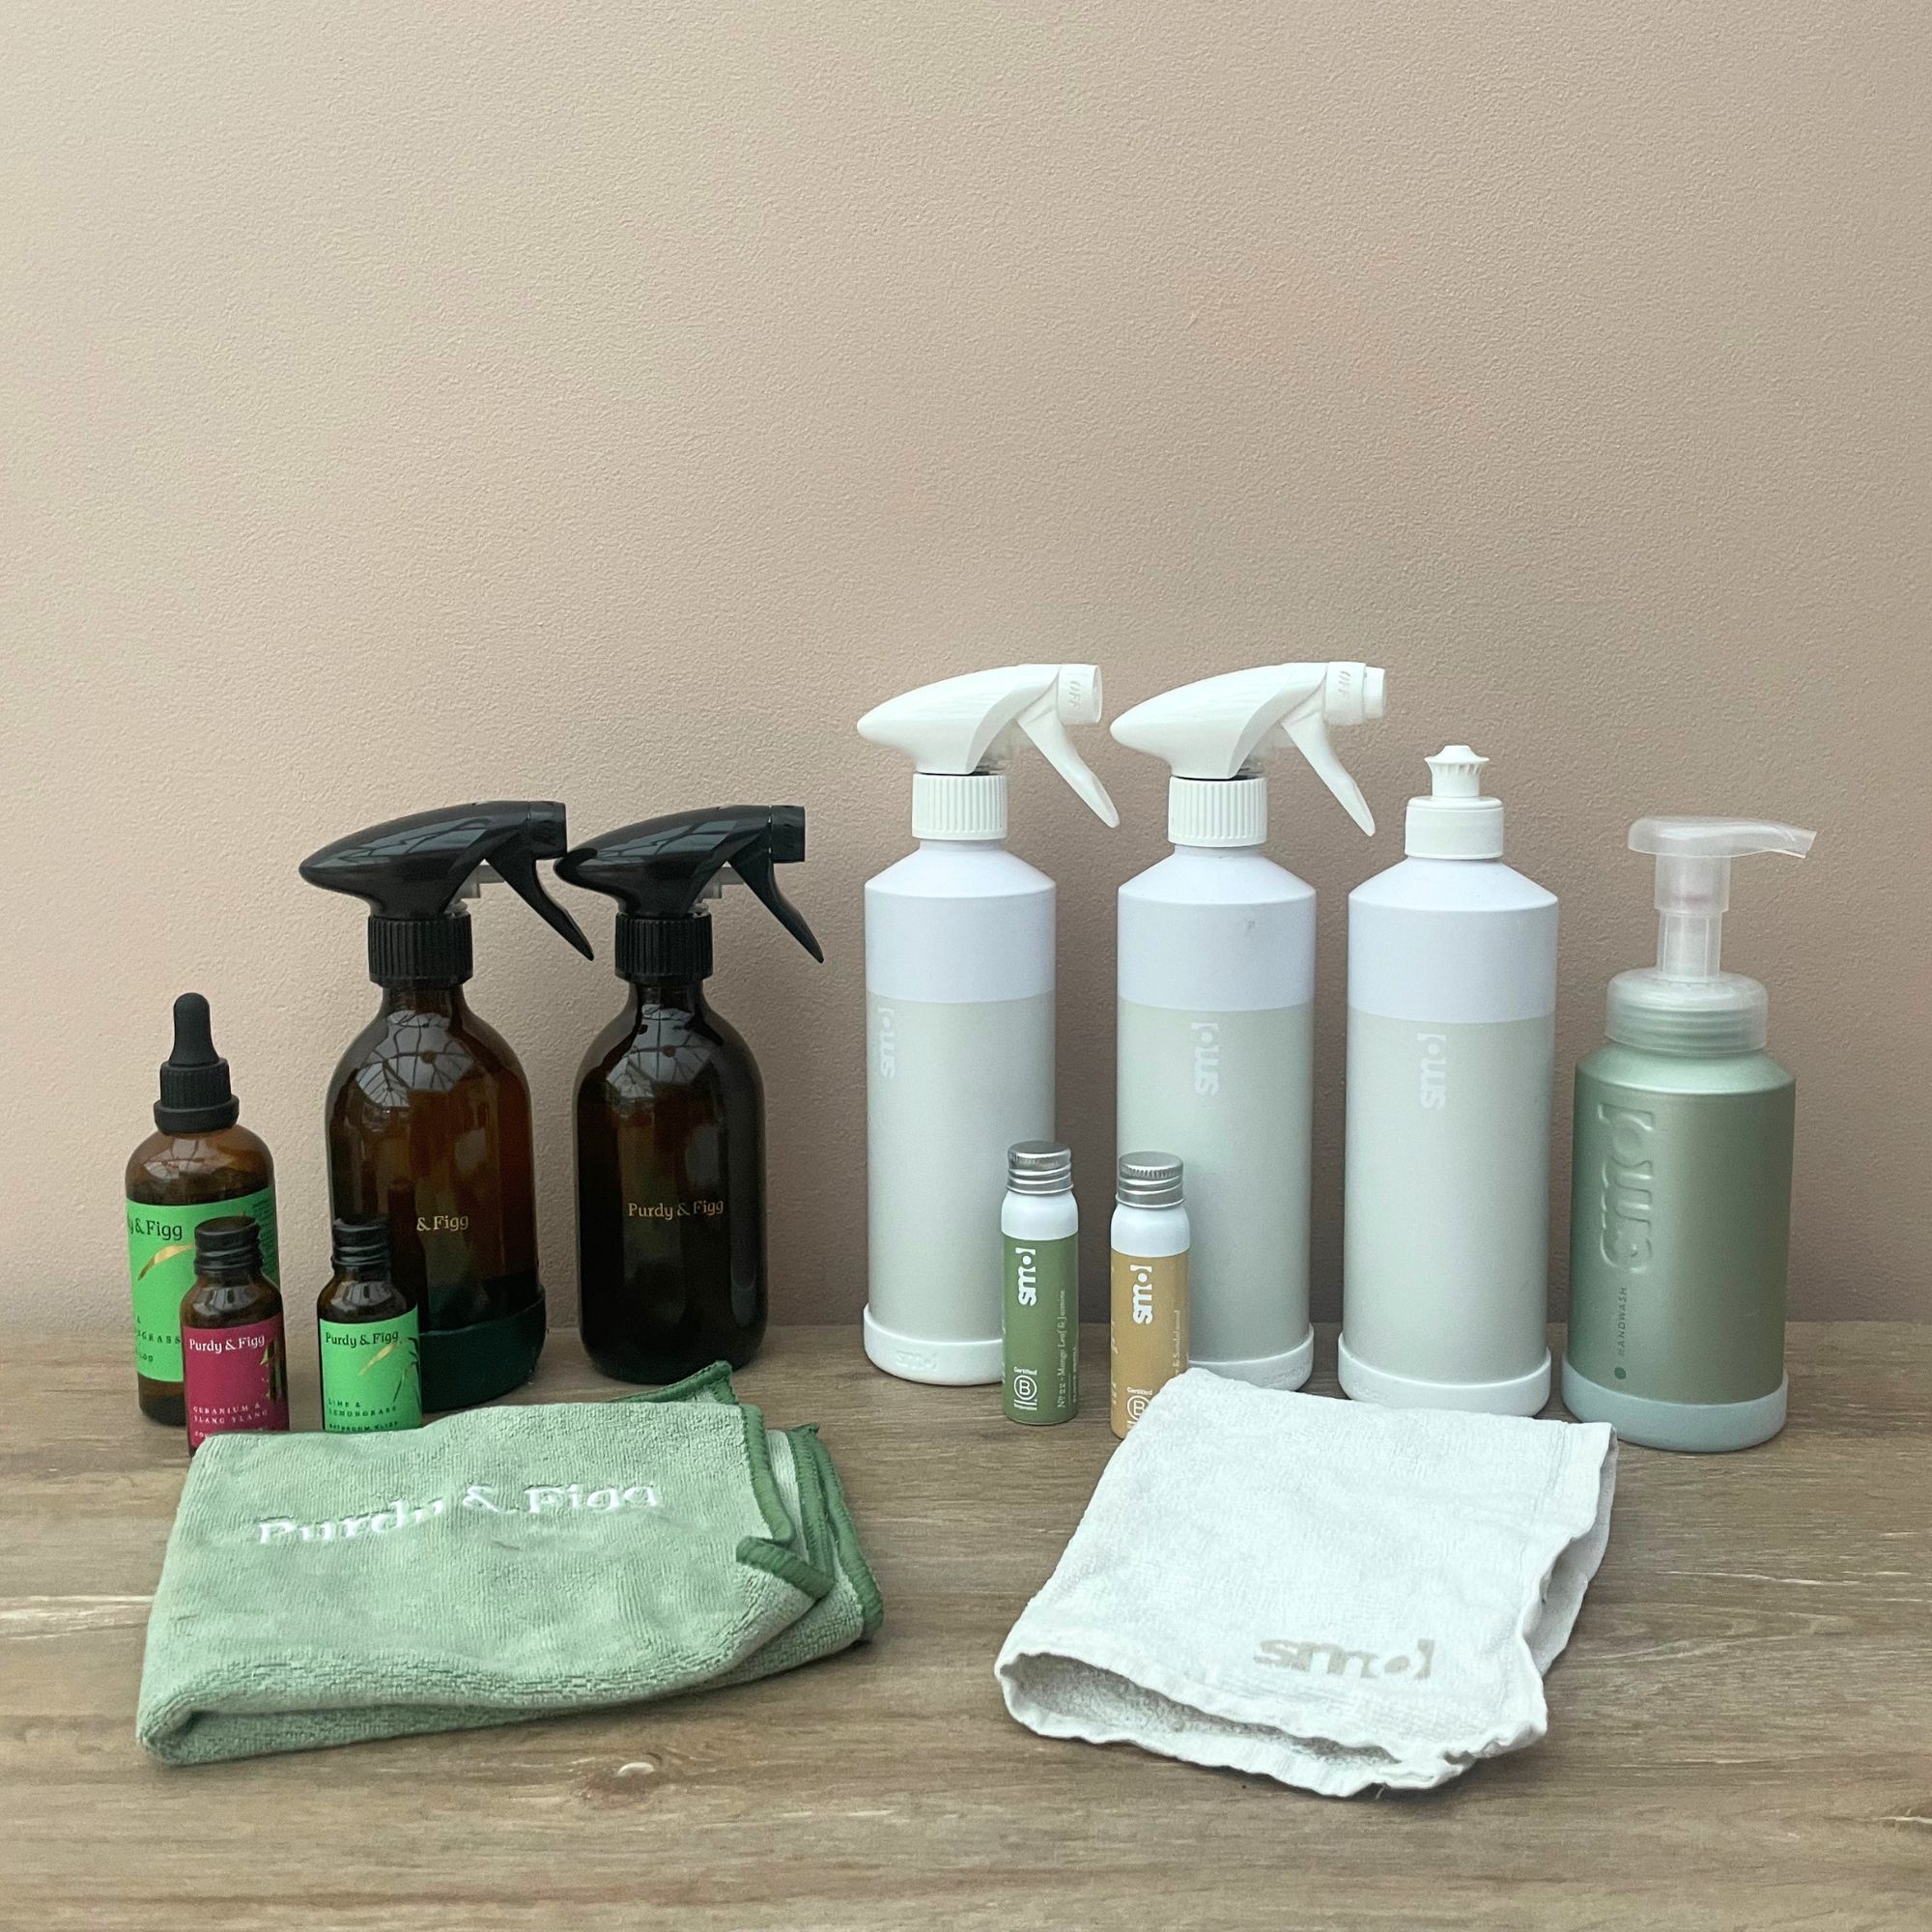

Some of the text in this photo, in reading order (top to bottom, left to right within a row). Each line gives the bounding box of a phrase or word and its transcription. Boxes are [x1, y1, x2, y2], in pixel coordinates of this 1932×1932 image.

[1191, 1023, 1219, 1096] smol
[1417, 1033, 1447, 1109] smol
[1597, 1103, 1656, 1274] smol
[416, 1214, 469, 1232] & Figg
[628, 1200, 724, 1221] Purdy & Figg
[135, 1217, 145, 1235] &
[146, 1219, 183, 1241] Figg
[1015, 1247, 1037, 1306] smol
[1130, 1264, 1152, 1324] smol
[1617, 1287, 1628, 1357] HANDWASH
[189, 1335, 265, 1354] Purdy & Figg
[326, 1331, 399, 1349] Purdy & Figg
[1057, 1330, 1067, 1347] Leaf
[1057, 1350, 1067, 1376] Mango
[193, 1404, 248, 1414] GERANIUM
[328, 1398, 349, 1407] LIME
[328, 1406, 397, 1417] LEMONGRASS
[462, 1483, 519, 1515] &
[1253, 1638, 1435, 1681] smol
